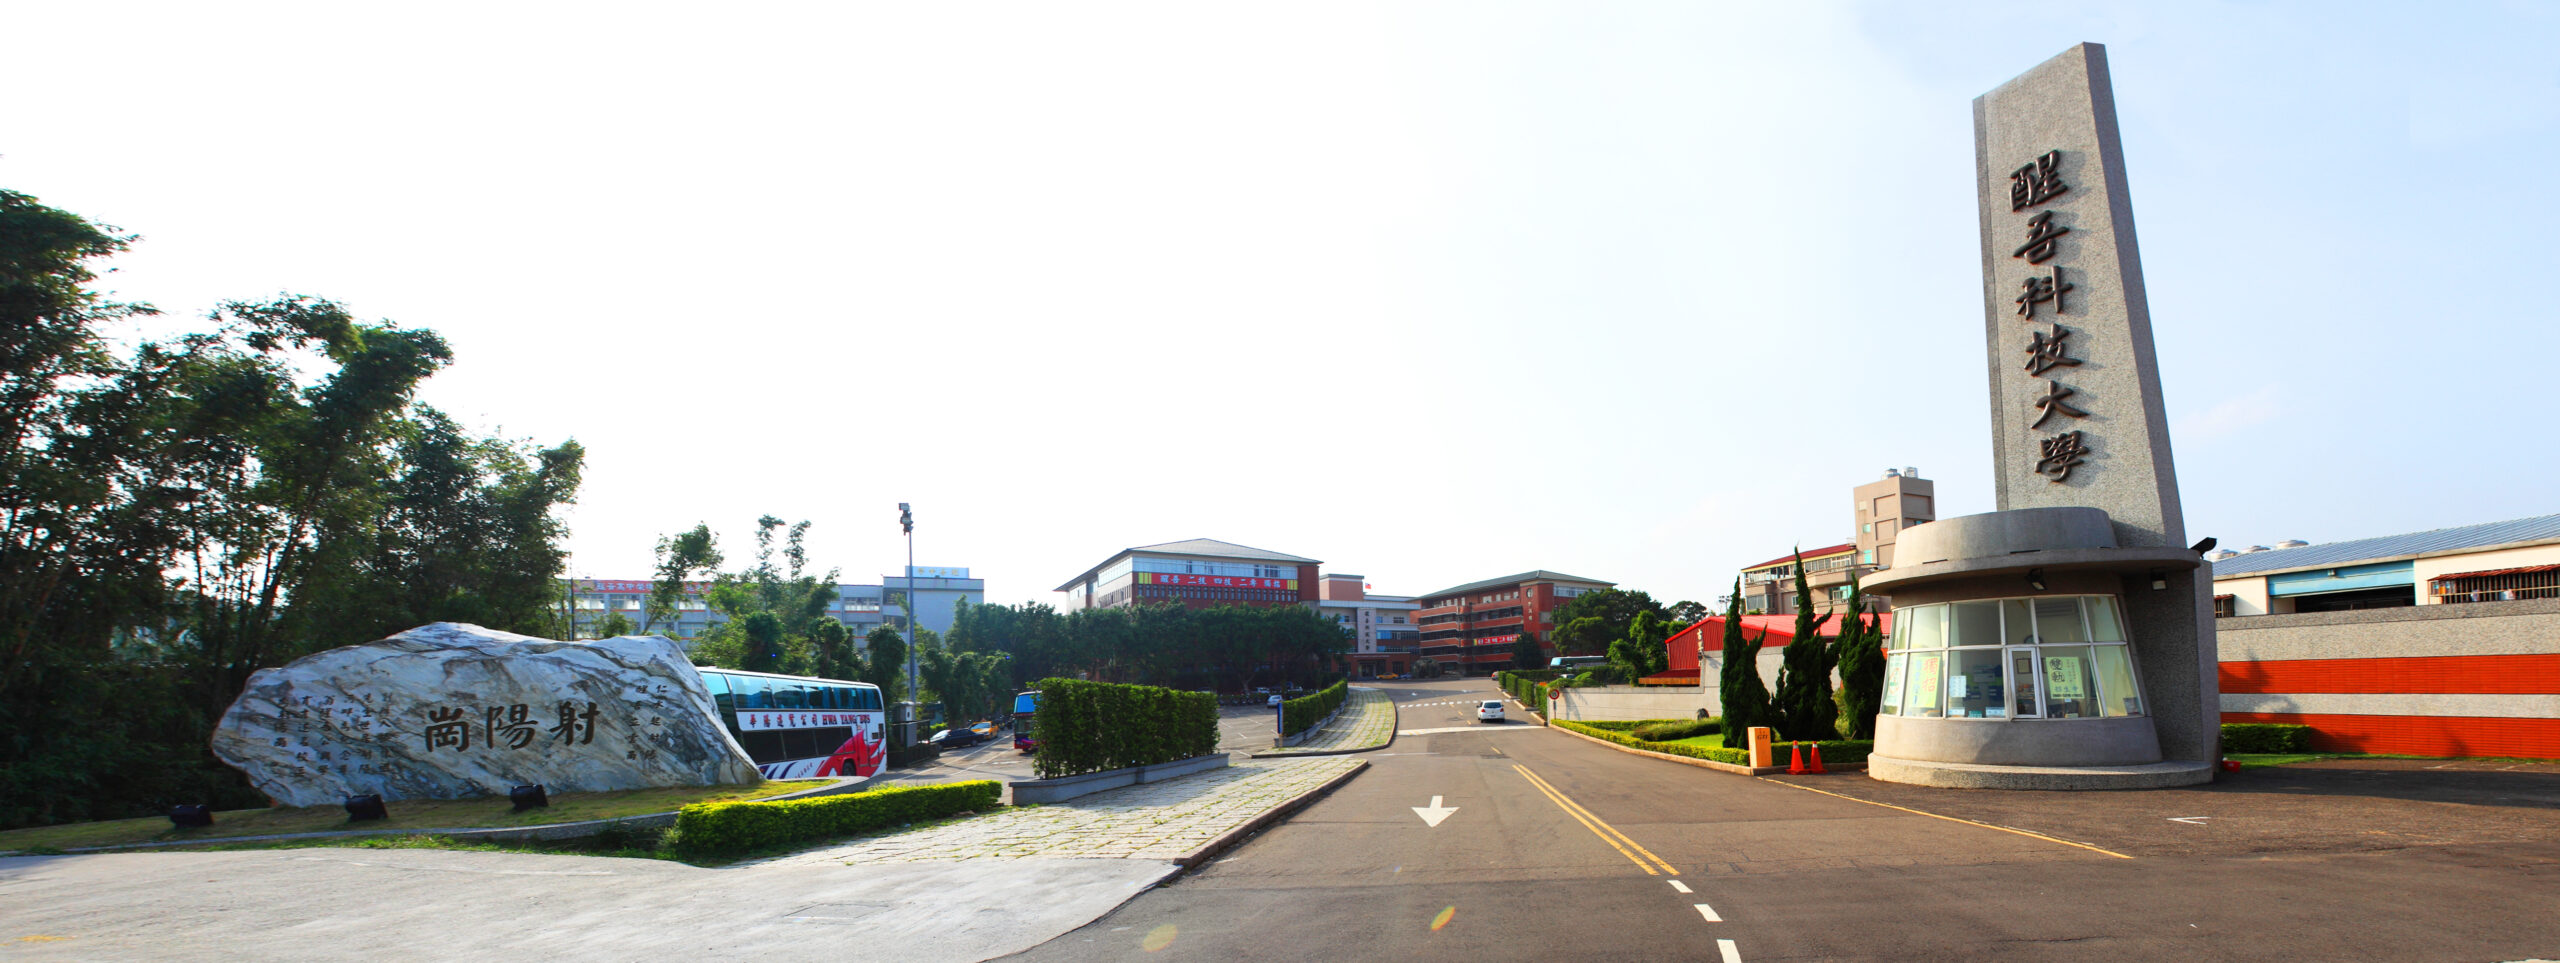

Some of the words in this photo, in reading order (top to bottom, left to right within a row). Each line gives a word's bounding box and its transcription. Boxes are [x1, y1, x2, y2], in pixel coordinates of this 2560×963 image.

[2009, 149, 2090, 482] 醒吾科技大學
[822, 715, 838, 725] HWA
